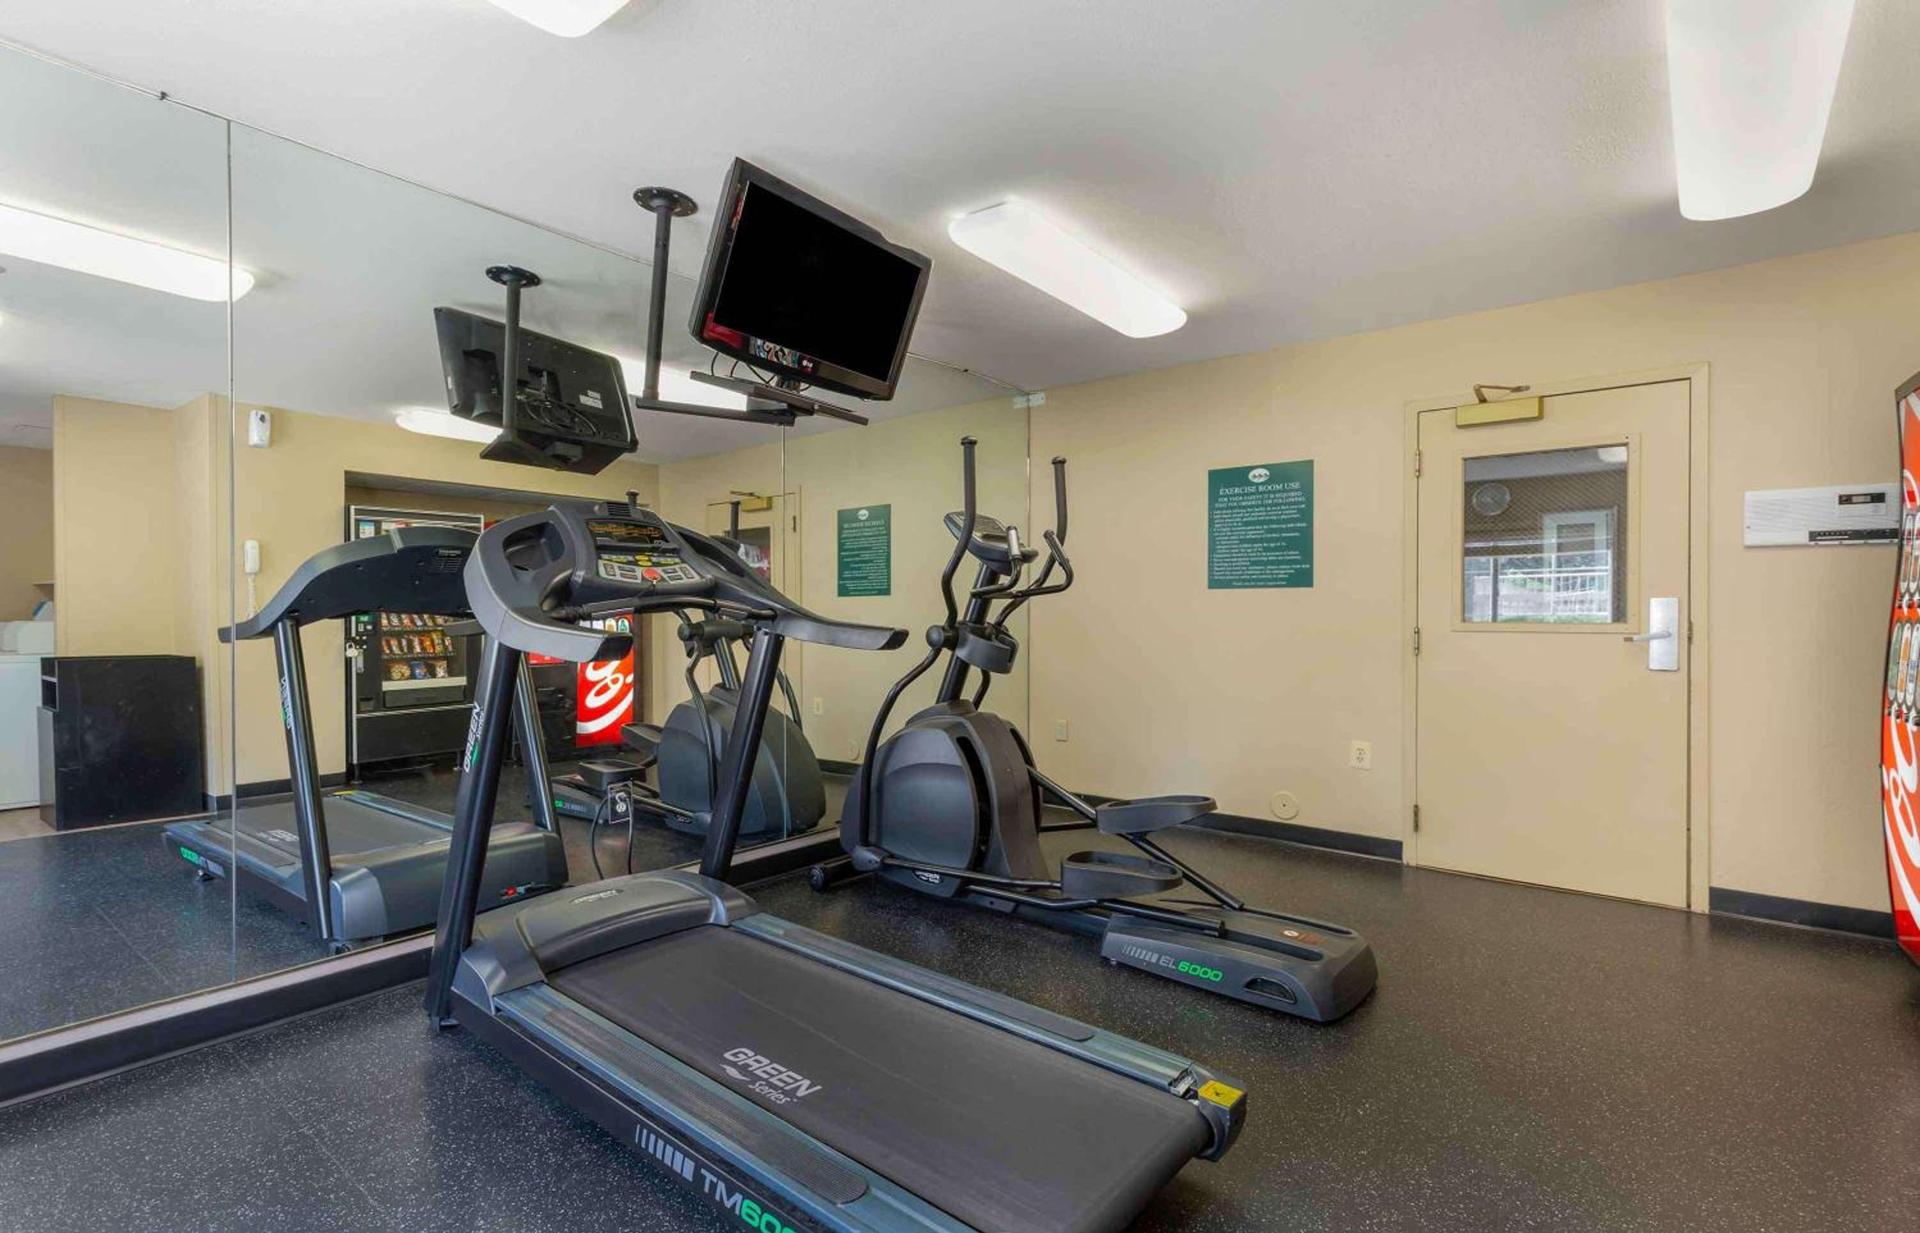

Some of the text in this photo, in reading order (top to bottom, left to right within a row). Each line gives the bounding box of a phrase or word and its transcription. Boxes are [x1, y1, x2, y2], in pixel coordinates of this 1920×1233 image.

[1219, 481, 1301, 495] EXERCISE ROOM USE
[463, 701, 480, 773] GREEN
[1159, 955, 1223, 981] EL6000
[723, 1048, 822, 1097] GREEN
[748, 1081, 791, 1104] Series
[701, 1168, 797, 1233] TM60
